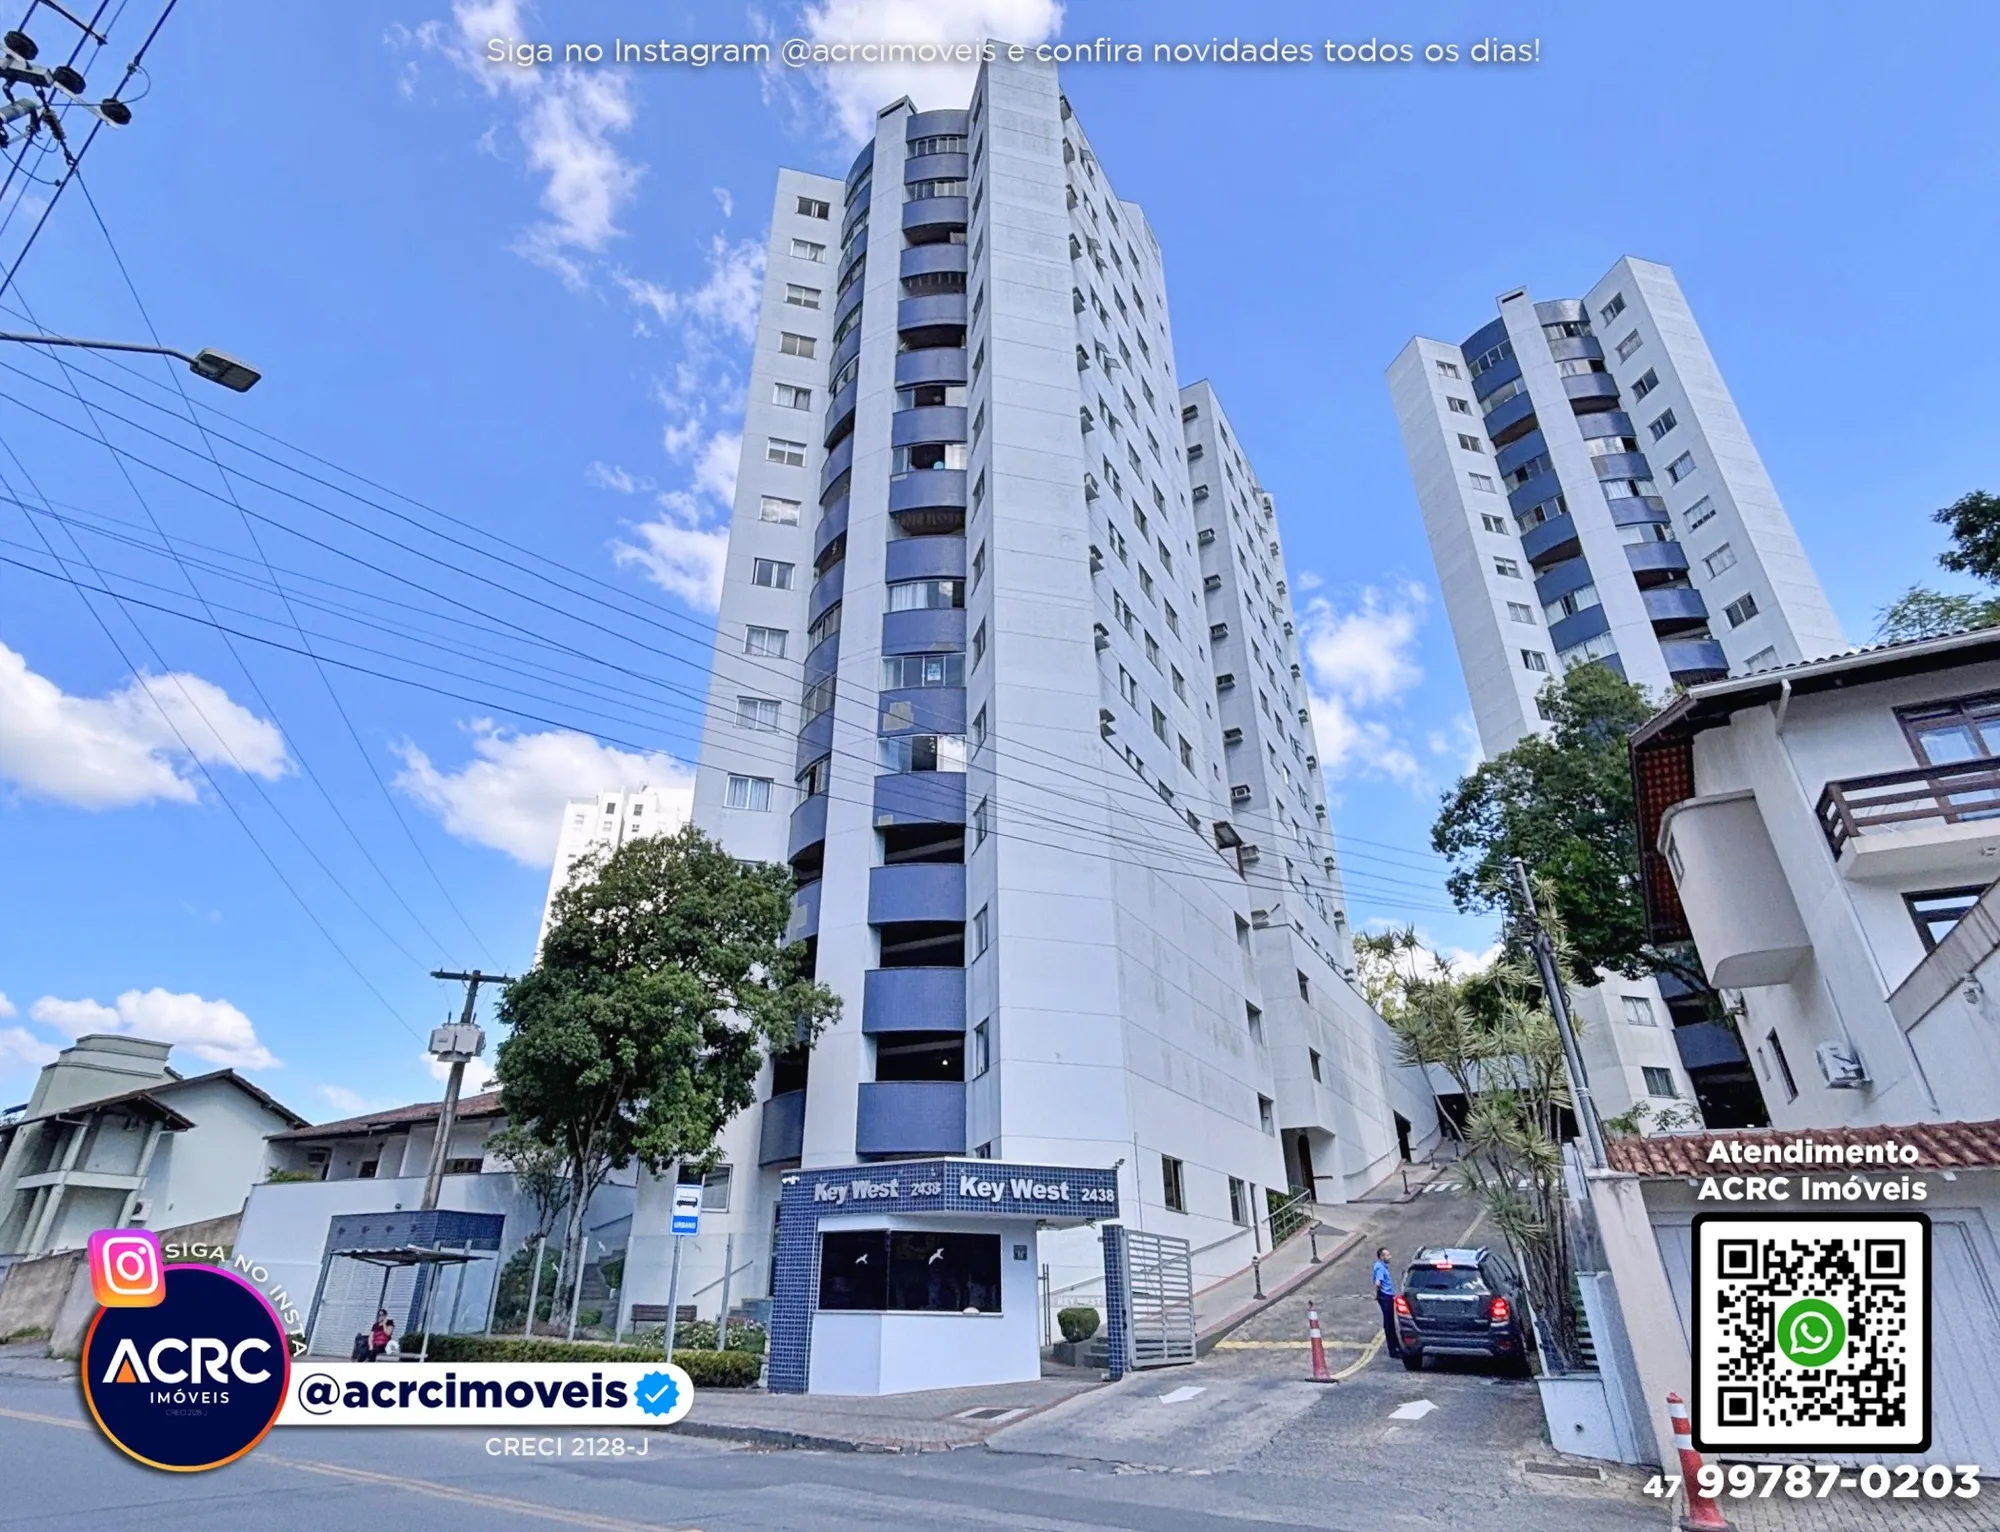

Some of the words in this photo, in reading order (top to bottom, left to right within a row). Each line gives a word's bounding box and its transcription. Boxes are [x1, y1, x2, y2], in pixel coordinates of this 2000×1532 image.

[814, 1182, 849, 1205] Key
[852, 1178, 899, 1200] West
[910, 1181, 941, 1197] 2438
[959, 1176, 1005, 1203] Key
[1010, 1178, 1070, 1201] West
[1081, 1187, 1115, 1203] 2438
